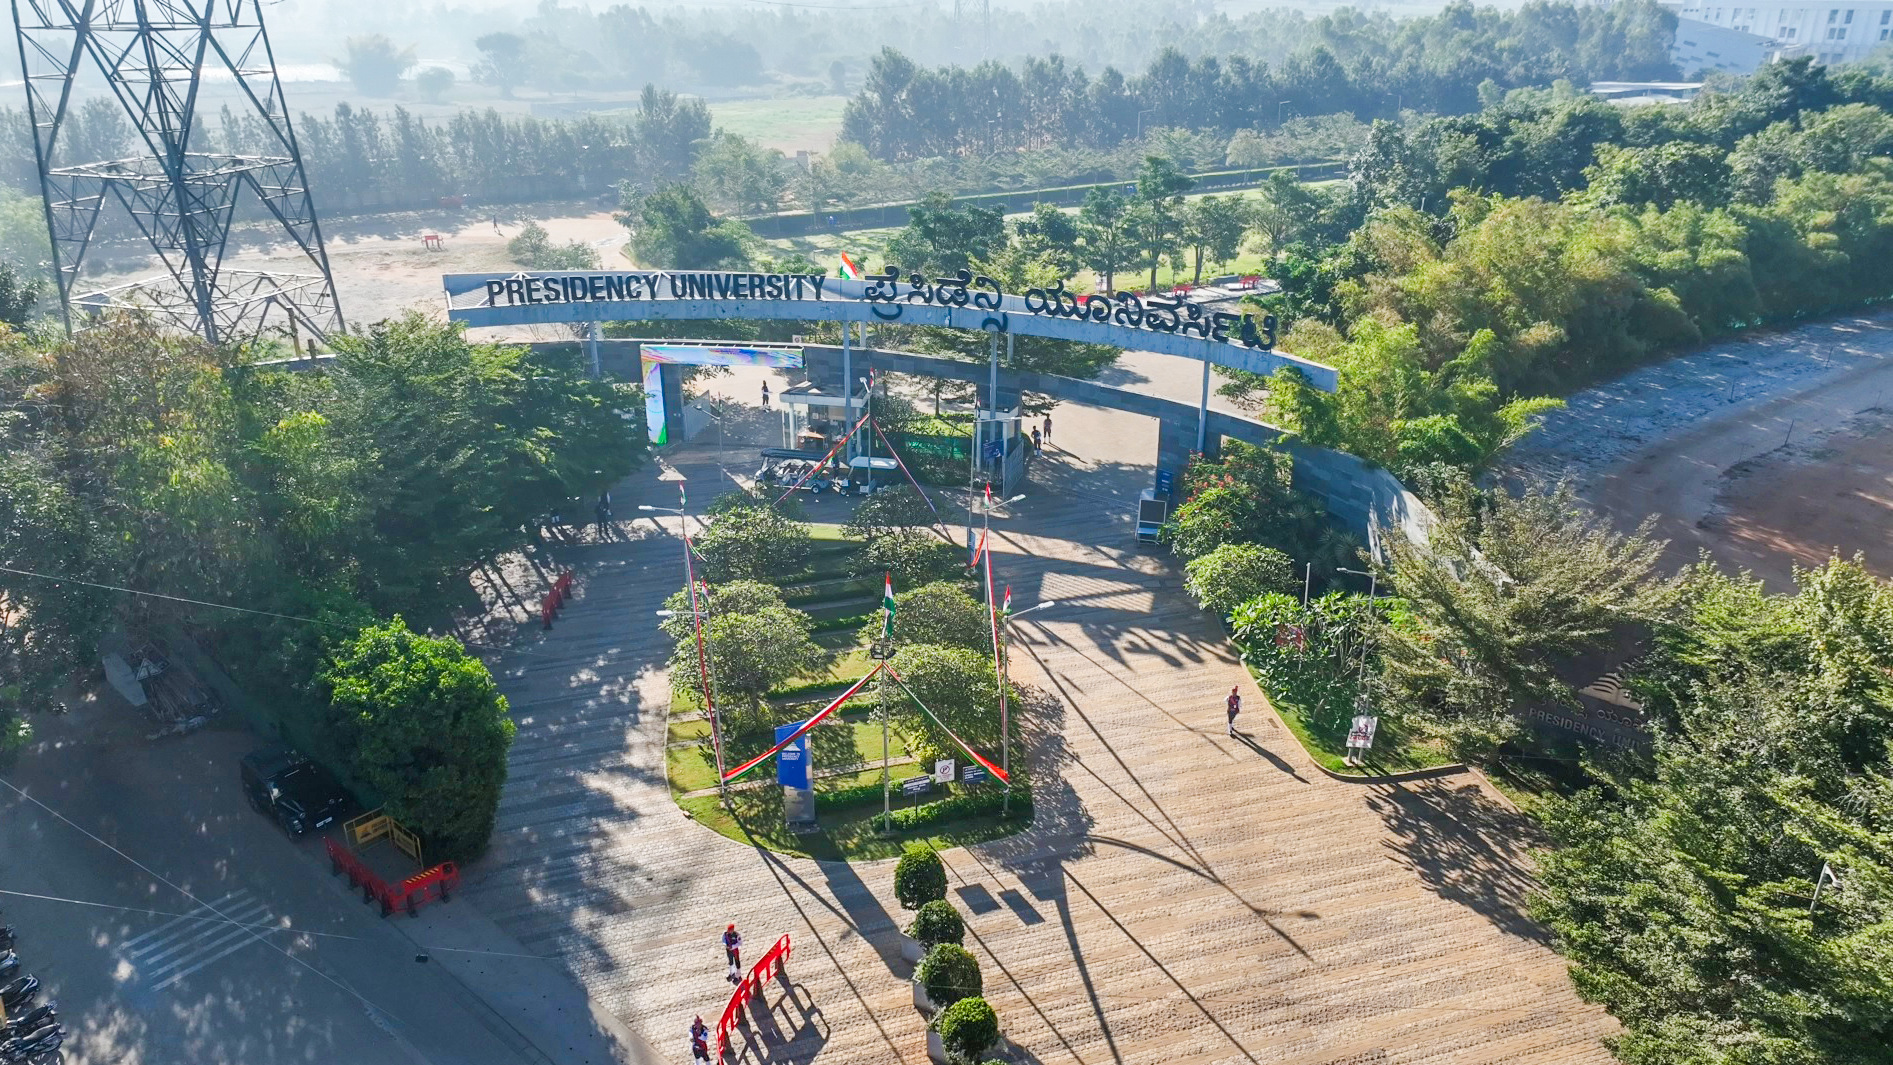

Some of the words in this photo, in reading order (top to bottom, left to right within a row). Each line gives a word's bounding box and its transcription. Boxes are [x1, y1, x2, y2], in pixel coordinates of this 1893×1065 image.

[486, 275, 660, 306] PRESIDENCY
[670, 273, 827, 301] UNIVERSITY
[865, 265, 1009, 332] ಪ್ರೆಸಿಡೆನ್ಸಿ
[1024, 279, 1277, 350] ಯೂನಿವರ್ಸಿಟಿ
[1529, 707, 1606, 739] PRESIDENCY
